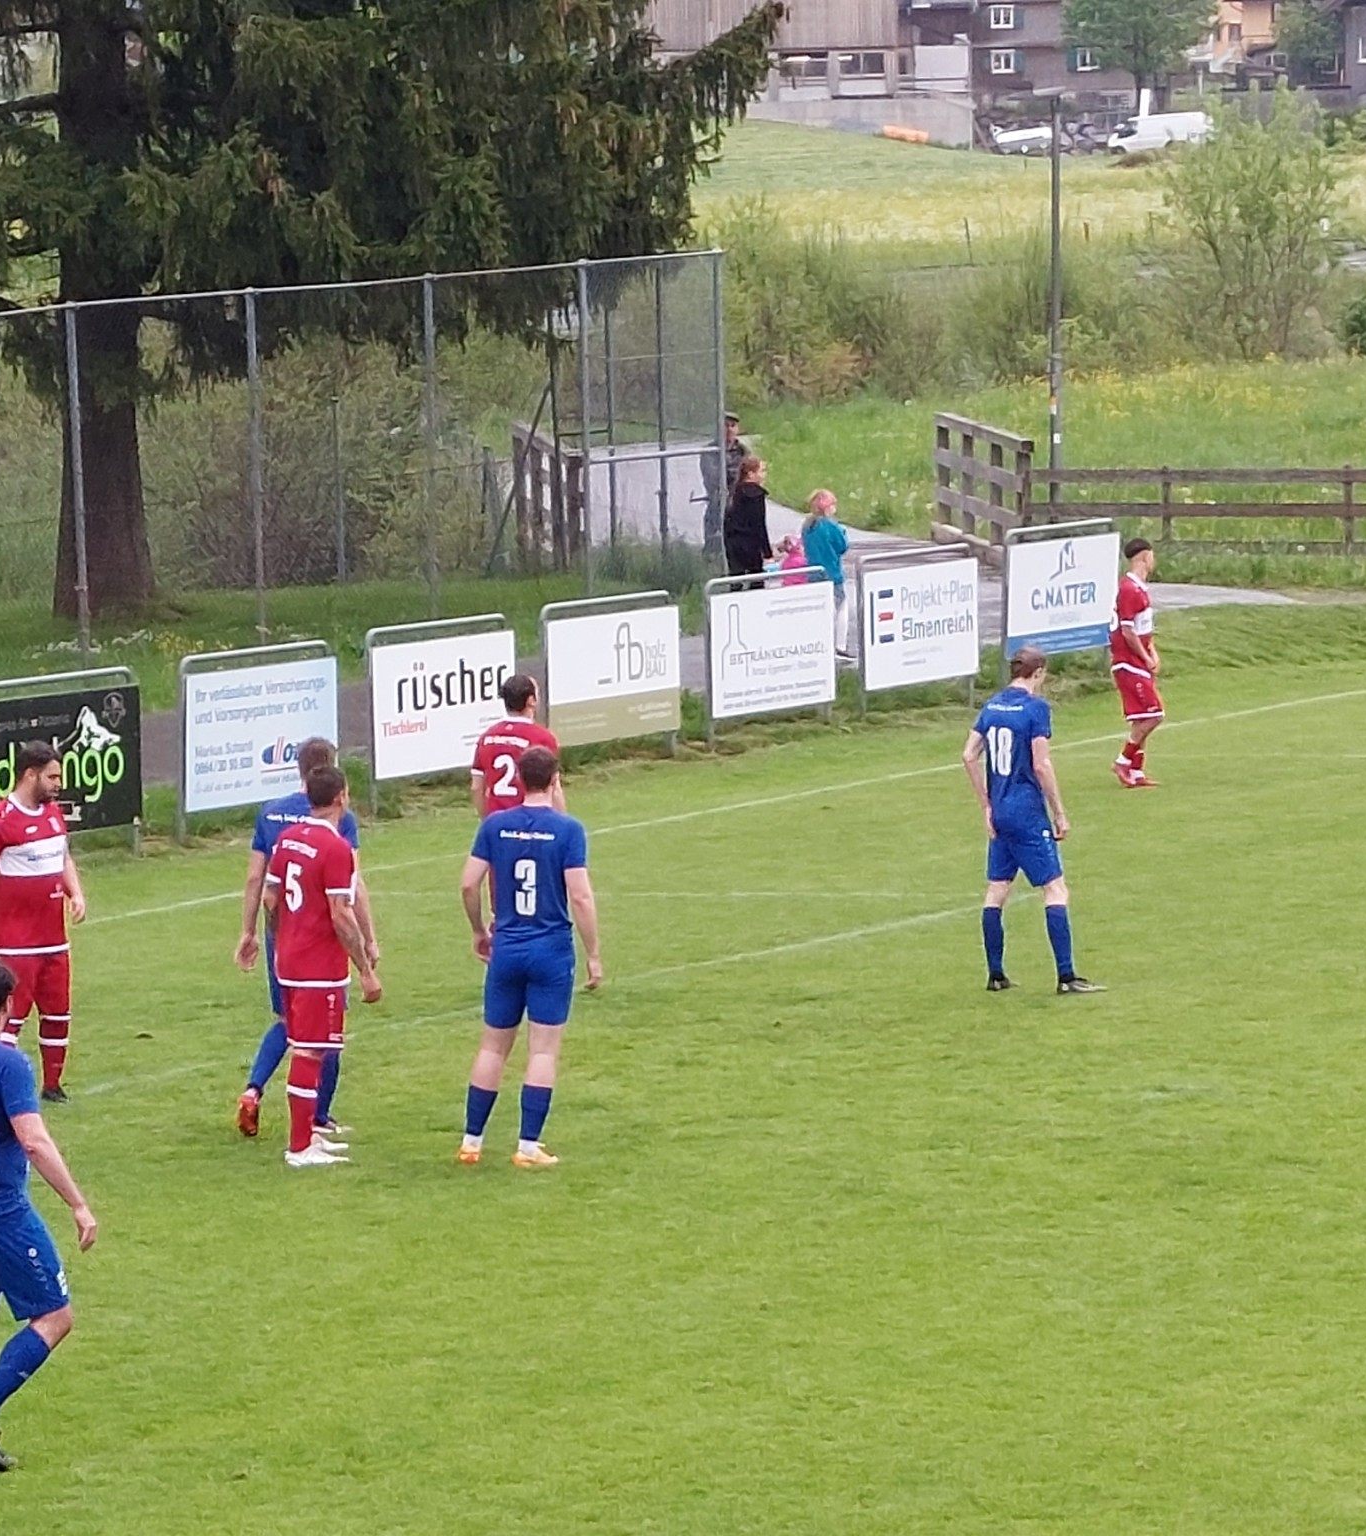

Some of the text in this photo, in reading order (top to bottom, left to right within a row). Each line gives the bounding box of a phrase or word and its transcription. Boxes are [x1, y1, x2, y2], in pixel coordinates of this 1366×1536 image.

[900, 580, 974, 613] Projekt+Plan
[1031, 582, 1096, 610] C.NATTER
[397, 658, 507, 713] rüscher
[195, 711, 212, 724] und
[987, 726, 1013, 776] 18
[493, 754, 518, 796] 2
[285, 861, 303, 912] 5
[514, 859, 537, 916] 3
